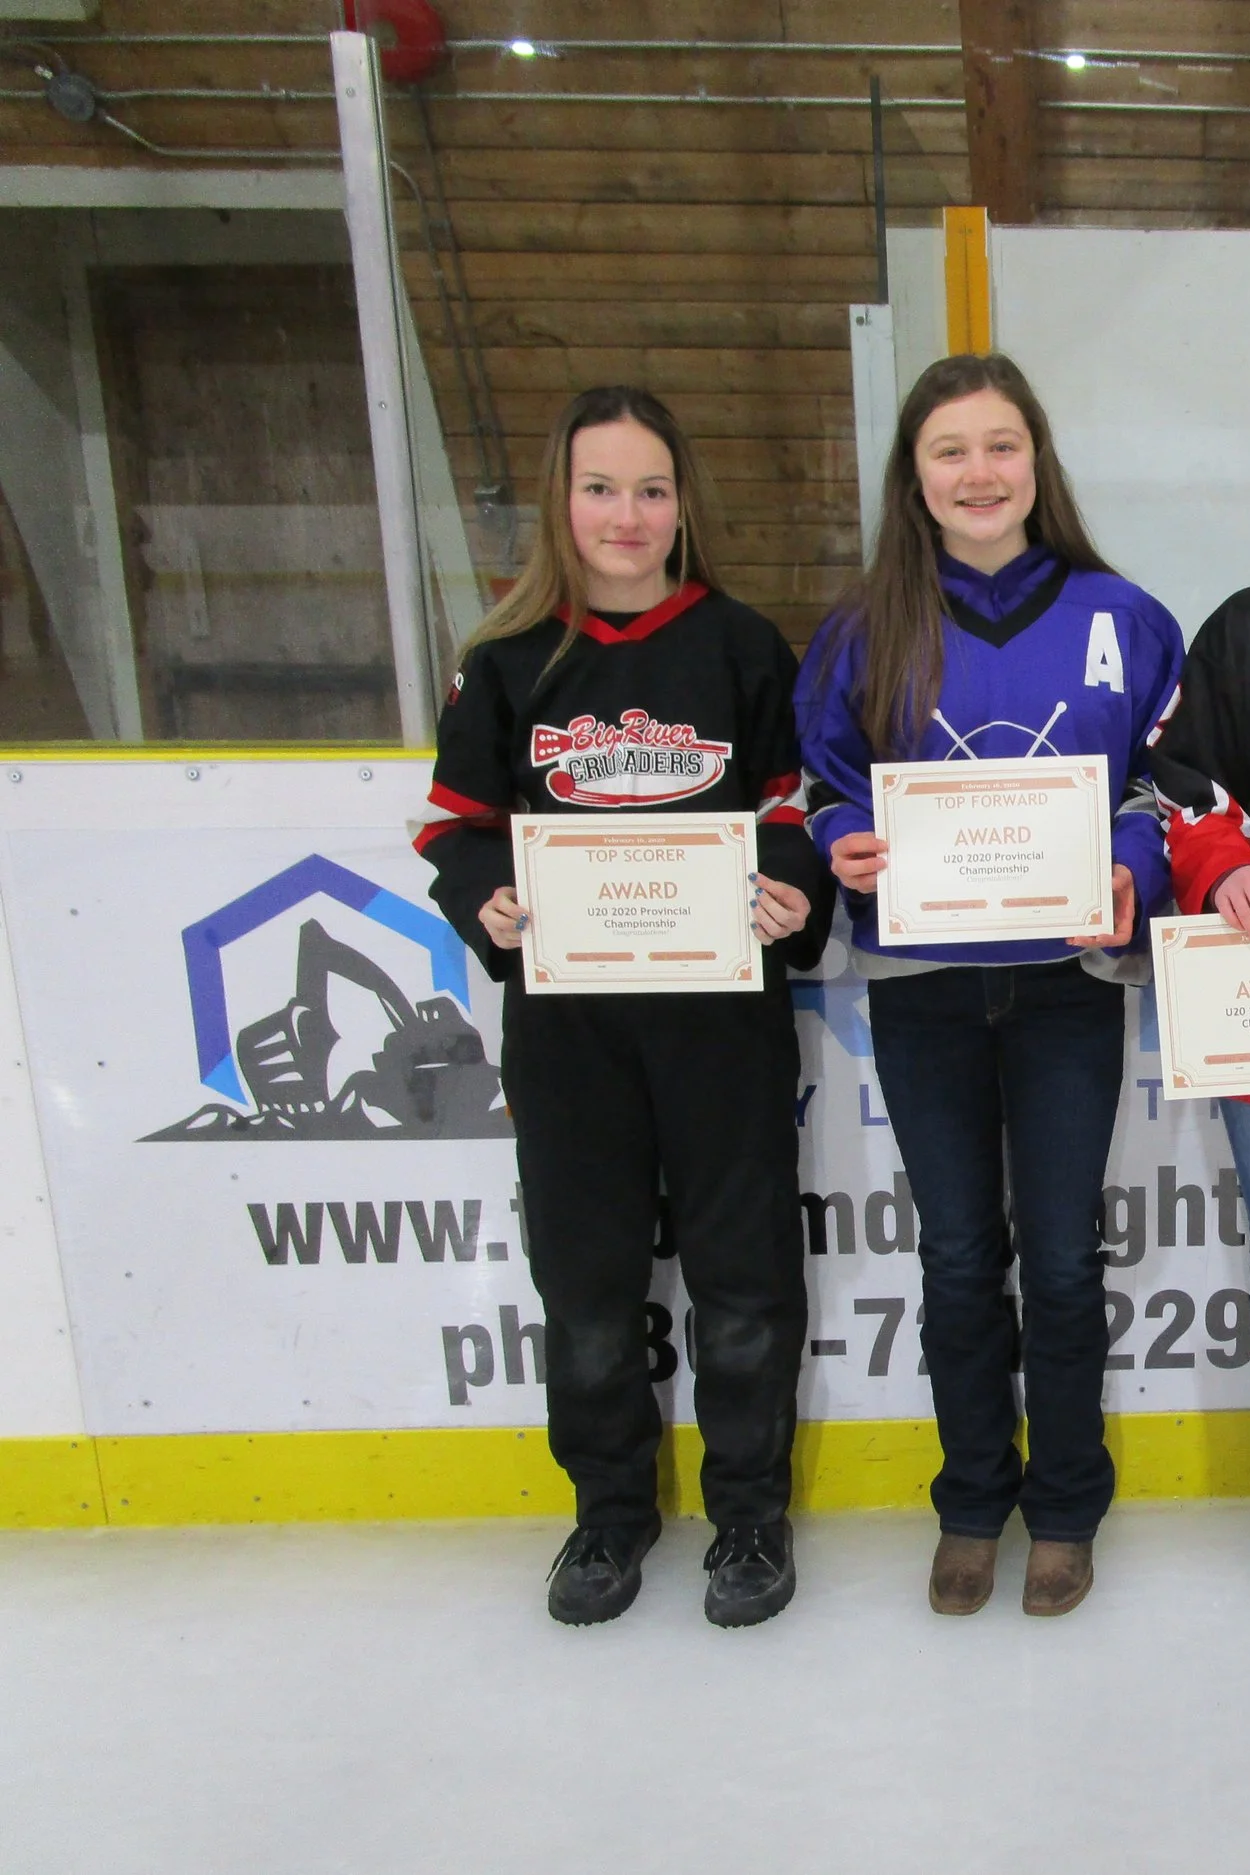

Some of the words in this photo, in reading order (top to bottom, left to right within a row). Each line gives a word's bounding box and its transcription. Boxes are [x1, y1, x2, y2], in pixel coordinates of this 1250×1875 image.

[1084, 612, 1124, 693] A
[568, 714, 616, 757] Big
[620, 709, 697, 747] River
[934, 796, 965, 809] TOP
[971, 793, 1048, 808] FORWARD
[954, 826, 1031, 847] AWARD
[585, 850, 617, 862] TOP
[624, 849, 686, 862] SCORER
[943, 854, 963, 863] U20
[967, 853, 992, 862] 2020
[994, 851, 1044, 861] Provincial
[959, 864, 1030, 876] Championship
[598, 881, 678, 900] AWARD
[587, 908, 608, 916] U20
[612, 907, 637, 916] 2020
[640, 906, 691, 915] Provincial
[604, 919, 677, 929] Championship
[1225, 1007, 1246, 1016] U20
